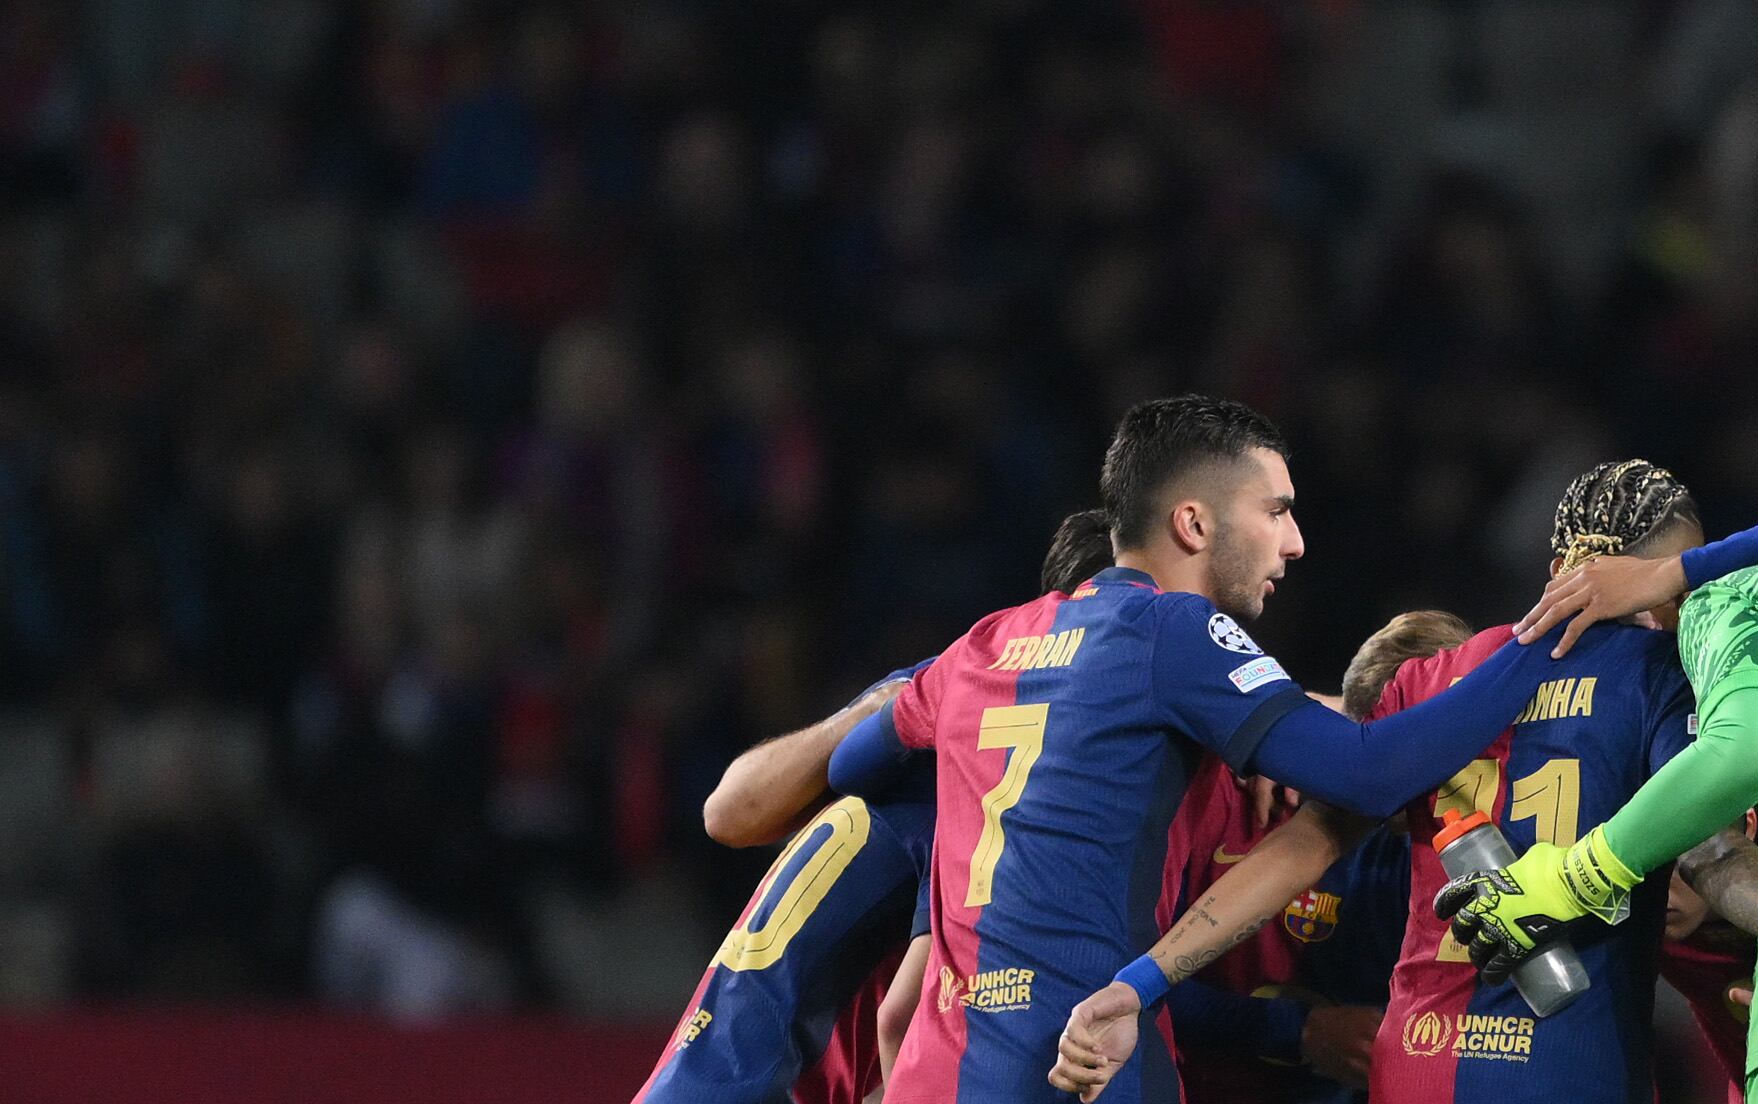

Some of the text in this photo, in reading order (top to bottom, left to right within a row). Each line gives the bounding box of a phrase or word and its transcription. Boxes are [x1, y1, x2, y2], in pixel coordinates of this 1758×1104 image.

[985, 627, 1086, 671] FERRAN
[963, 703, 1050, 908] 7
[967, 968, 1035, 992] UNHCR
[959, 984, 1031, 1007] ACNUR
[1456, 1014, 1536, 1036] UNHCR
[1451, 1033, 1533, 1055] ACNUR
[1475, 1051, 1502, 1060] Refugee
[1501, 1053, 1530, 1063] Agency
